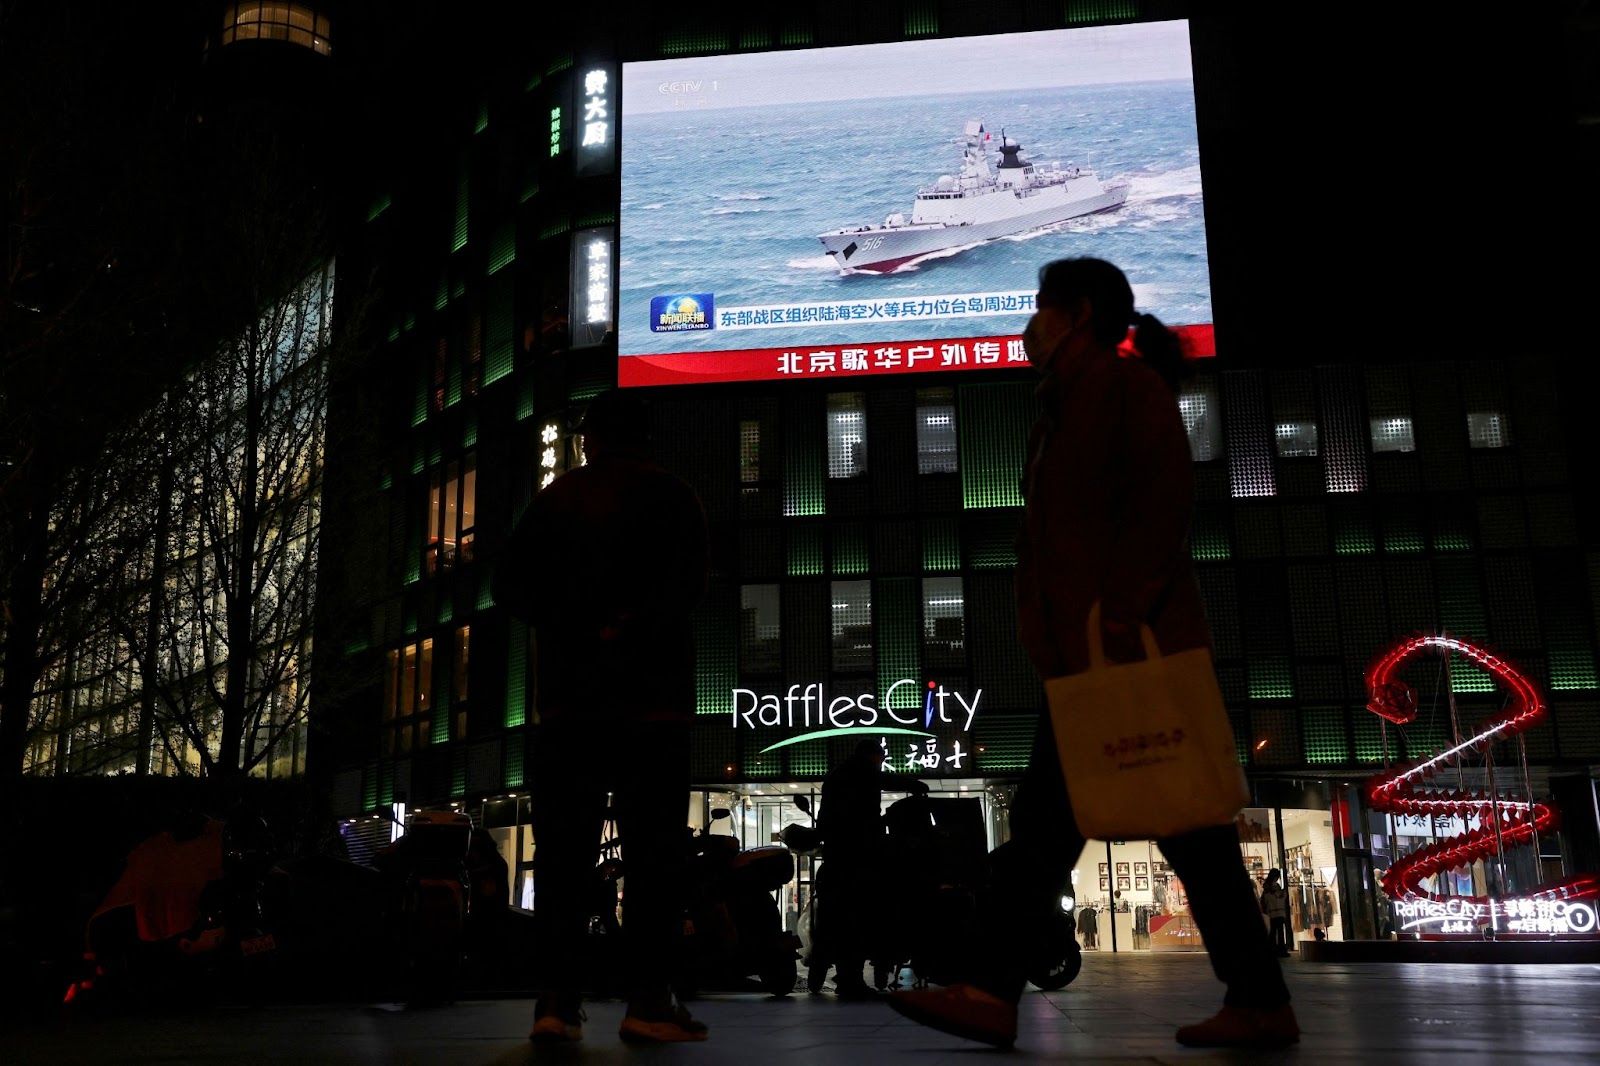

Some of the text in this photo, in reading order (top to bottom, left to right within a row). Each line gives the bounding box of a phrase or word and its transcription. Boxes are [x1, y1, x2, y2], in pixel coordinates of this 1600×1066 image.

[659, 79, 703, 95] CCTV
[582, 70, 608, 146] 费大厨
[861, 236, 885, 251] 516
[659, 311, 705, 325] 新闻联播
[731, 678, 982, 731] Raffles City
[1394, 900, 1445, 917] Raffles
[1446, 899, 1481, 919] City
